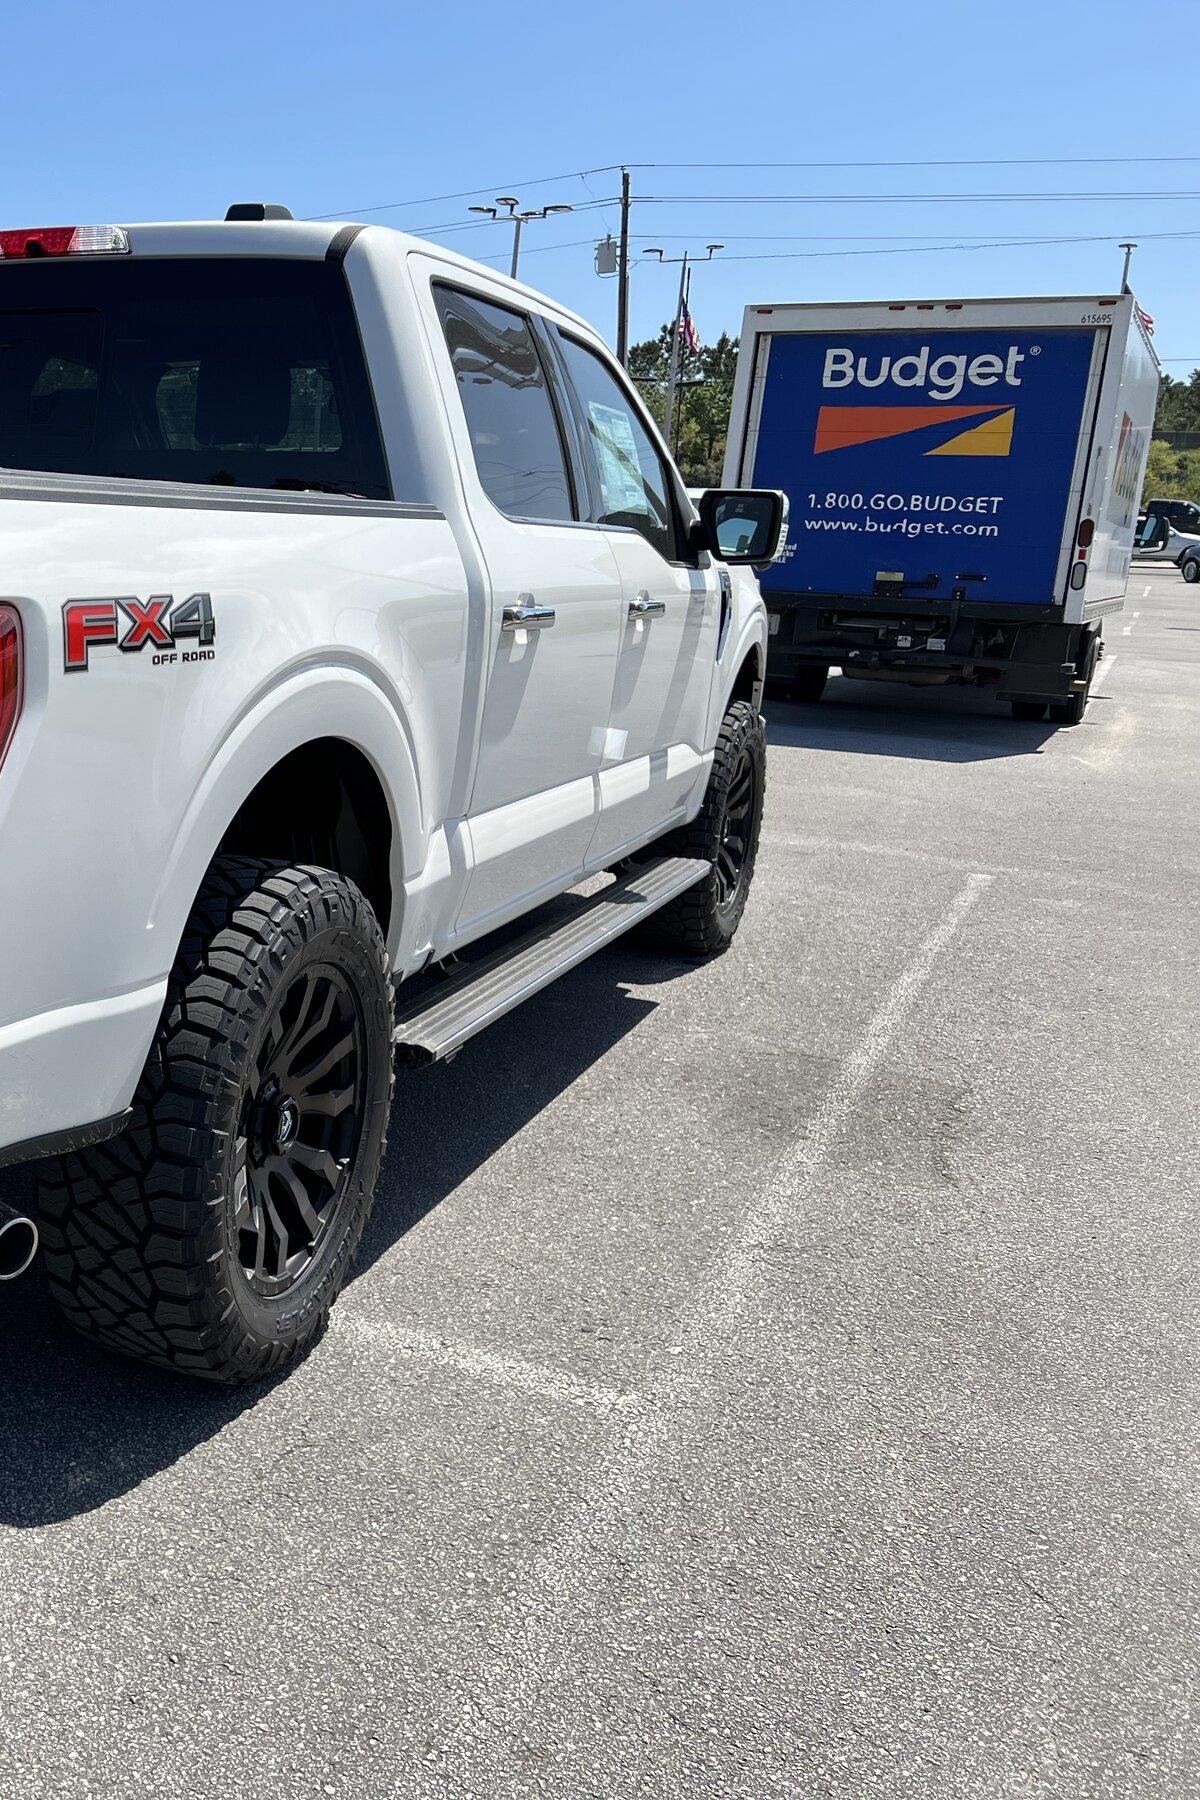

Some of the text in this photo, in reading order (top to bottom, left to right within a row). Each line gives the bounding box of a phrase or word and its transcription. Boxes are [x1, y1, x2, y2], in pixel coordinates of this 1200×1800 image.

[1081, 313, 1112, 324] 615695
[822, 346, 1025, 400] Budget
[808, 493, 1003, 514] 1.800.GO.BUDGET
[804, 516, 999, 538] www.budget.com
[61, 592, 216, 675] FX4
[152, 650, 215, 666] OFF ROAD
